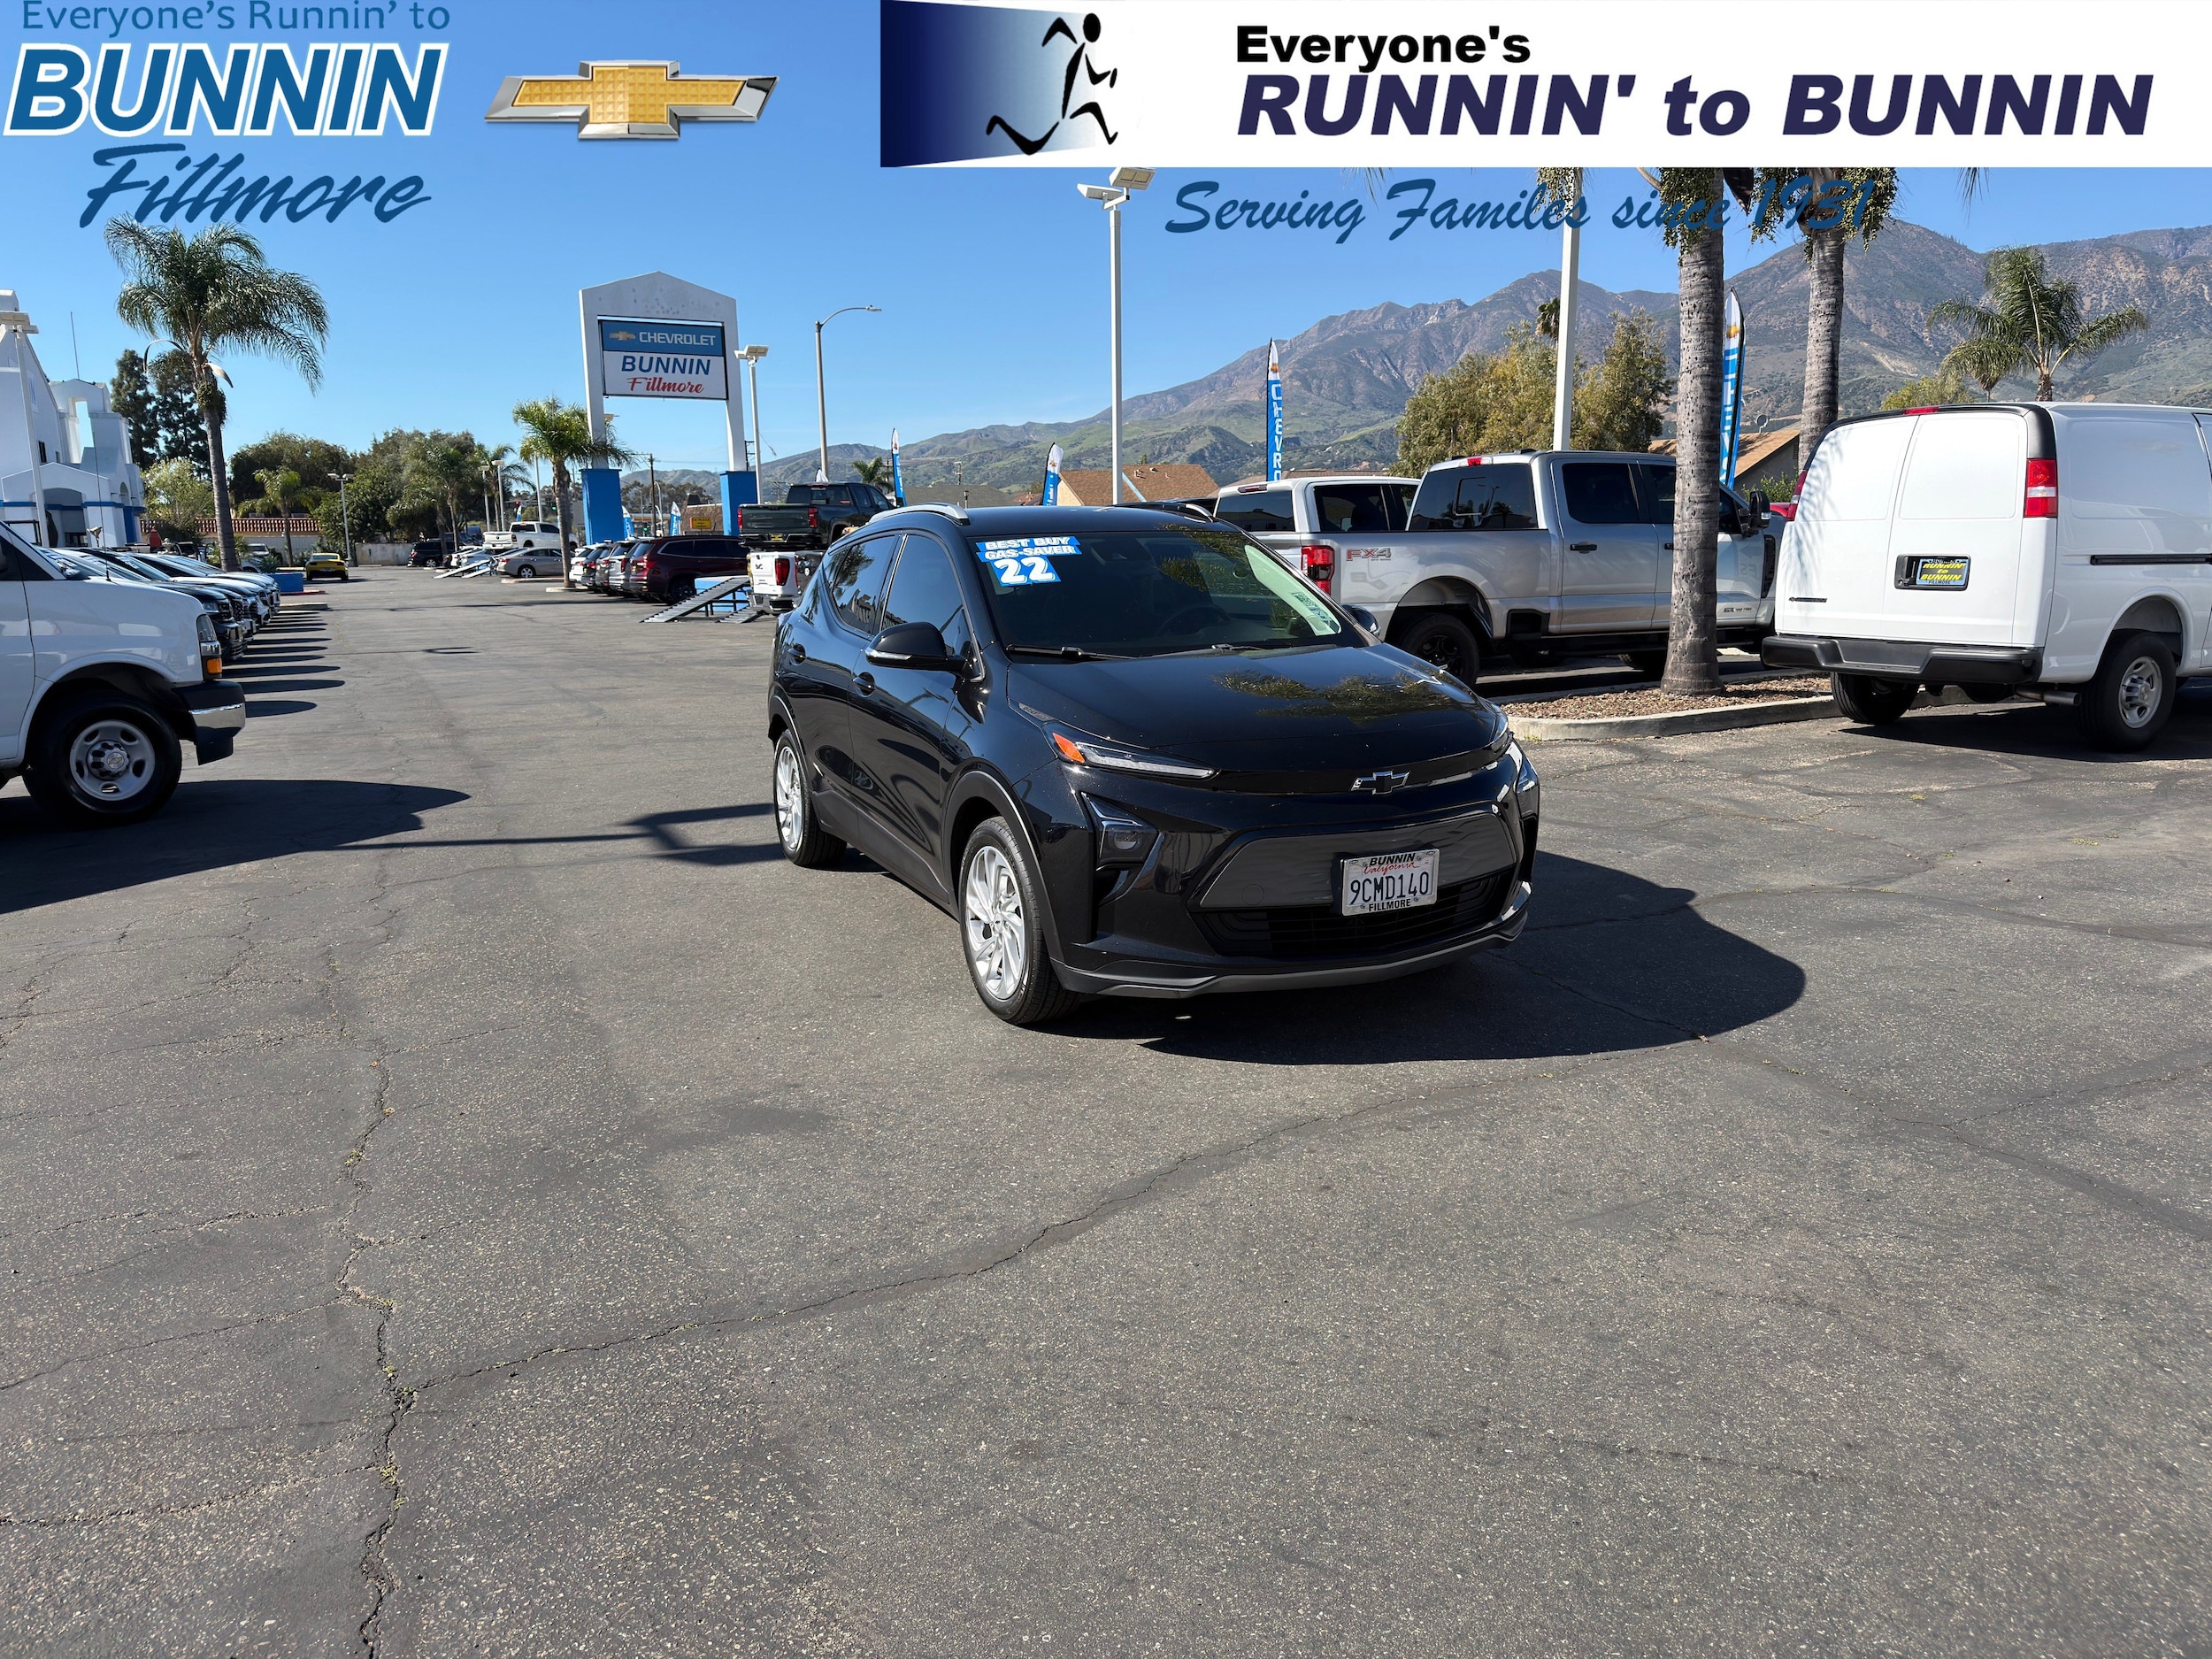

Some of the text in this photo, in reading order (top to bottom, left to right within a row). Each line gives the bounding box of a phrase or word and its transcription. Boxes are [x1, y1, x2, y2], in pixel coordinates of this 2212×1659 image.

[639, 332, 717, 346] CHEVROLET
[621, 355, 711, 376] BUNNIN
[626, 376, 705, 394] Fillmore
[985, 536, 1071, 550] BEST BUY
[984, 545, 1077, 560] GAS-SAVER
[1346, 548, 1392, 562] FX4
[993, 556, 1056, 585] 22
[1369, 853, 1417, 866] BUNNIN
[1363, 861, 1420, 876] California
[1349, 871, 1430, 906] 9CMD140
[1368, 898, 1411, 912] FILLMORE
